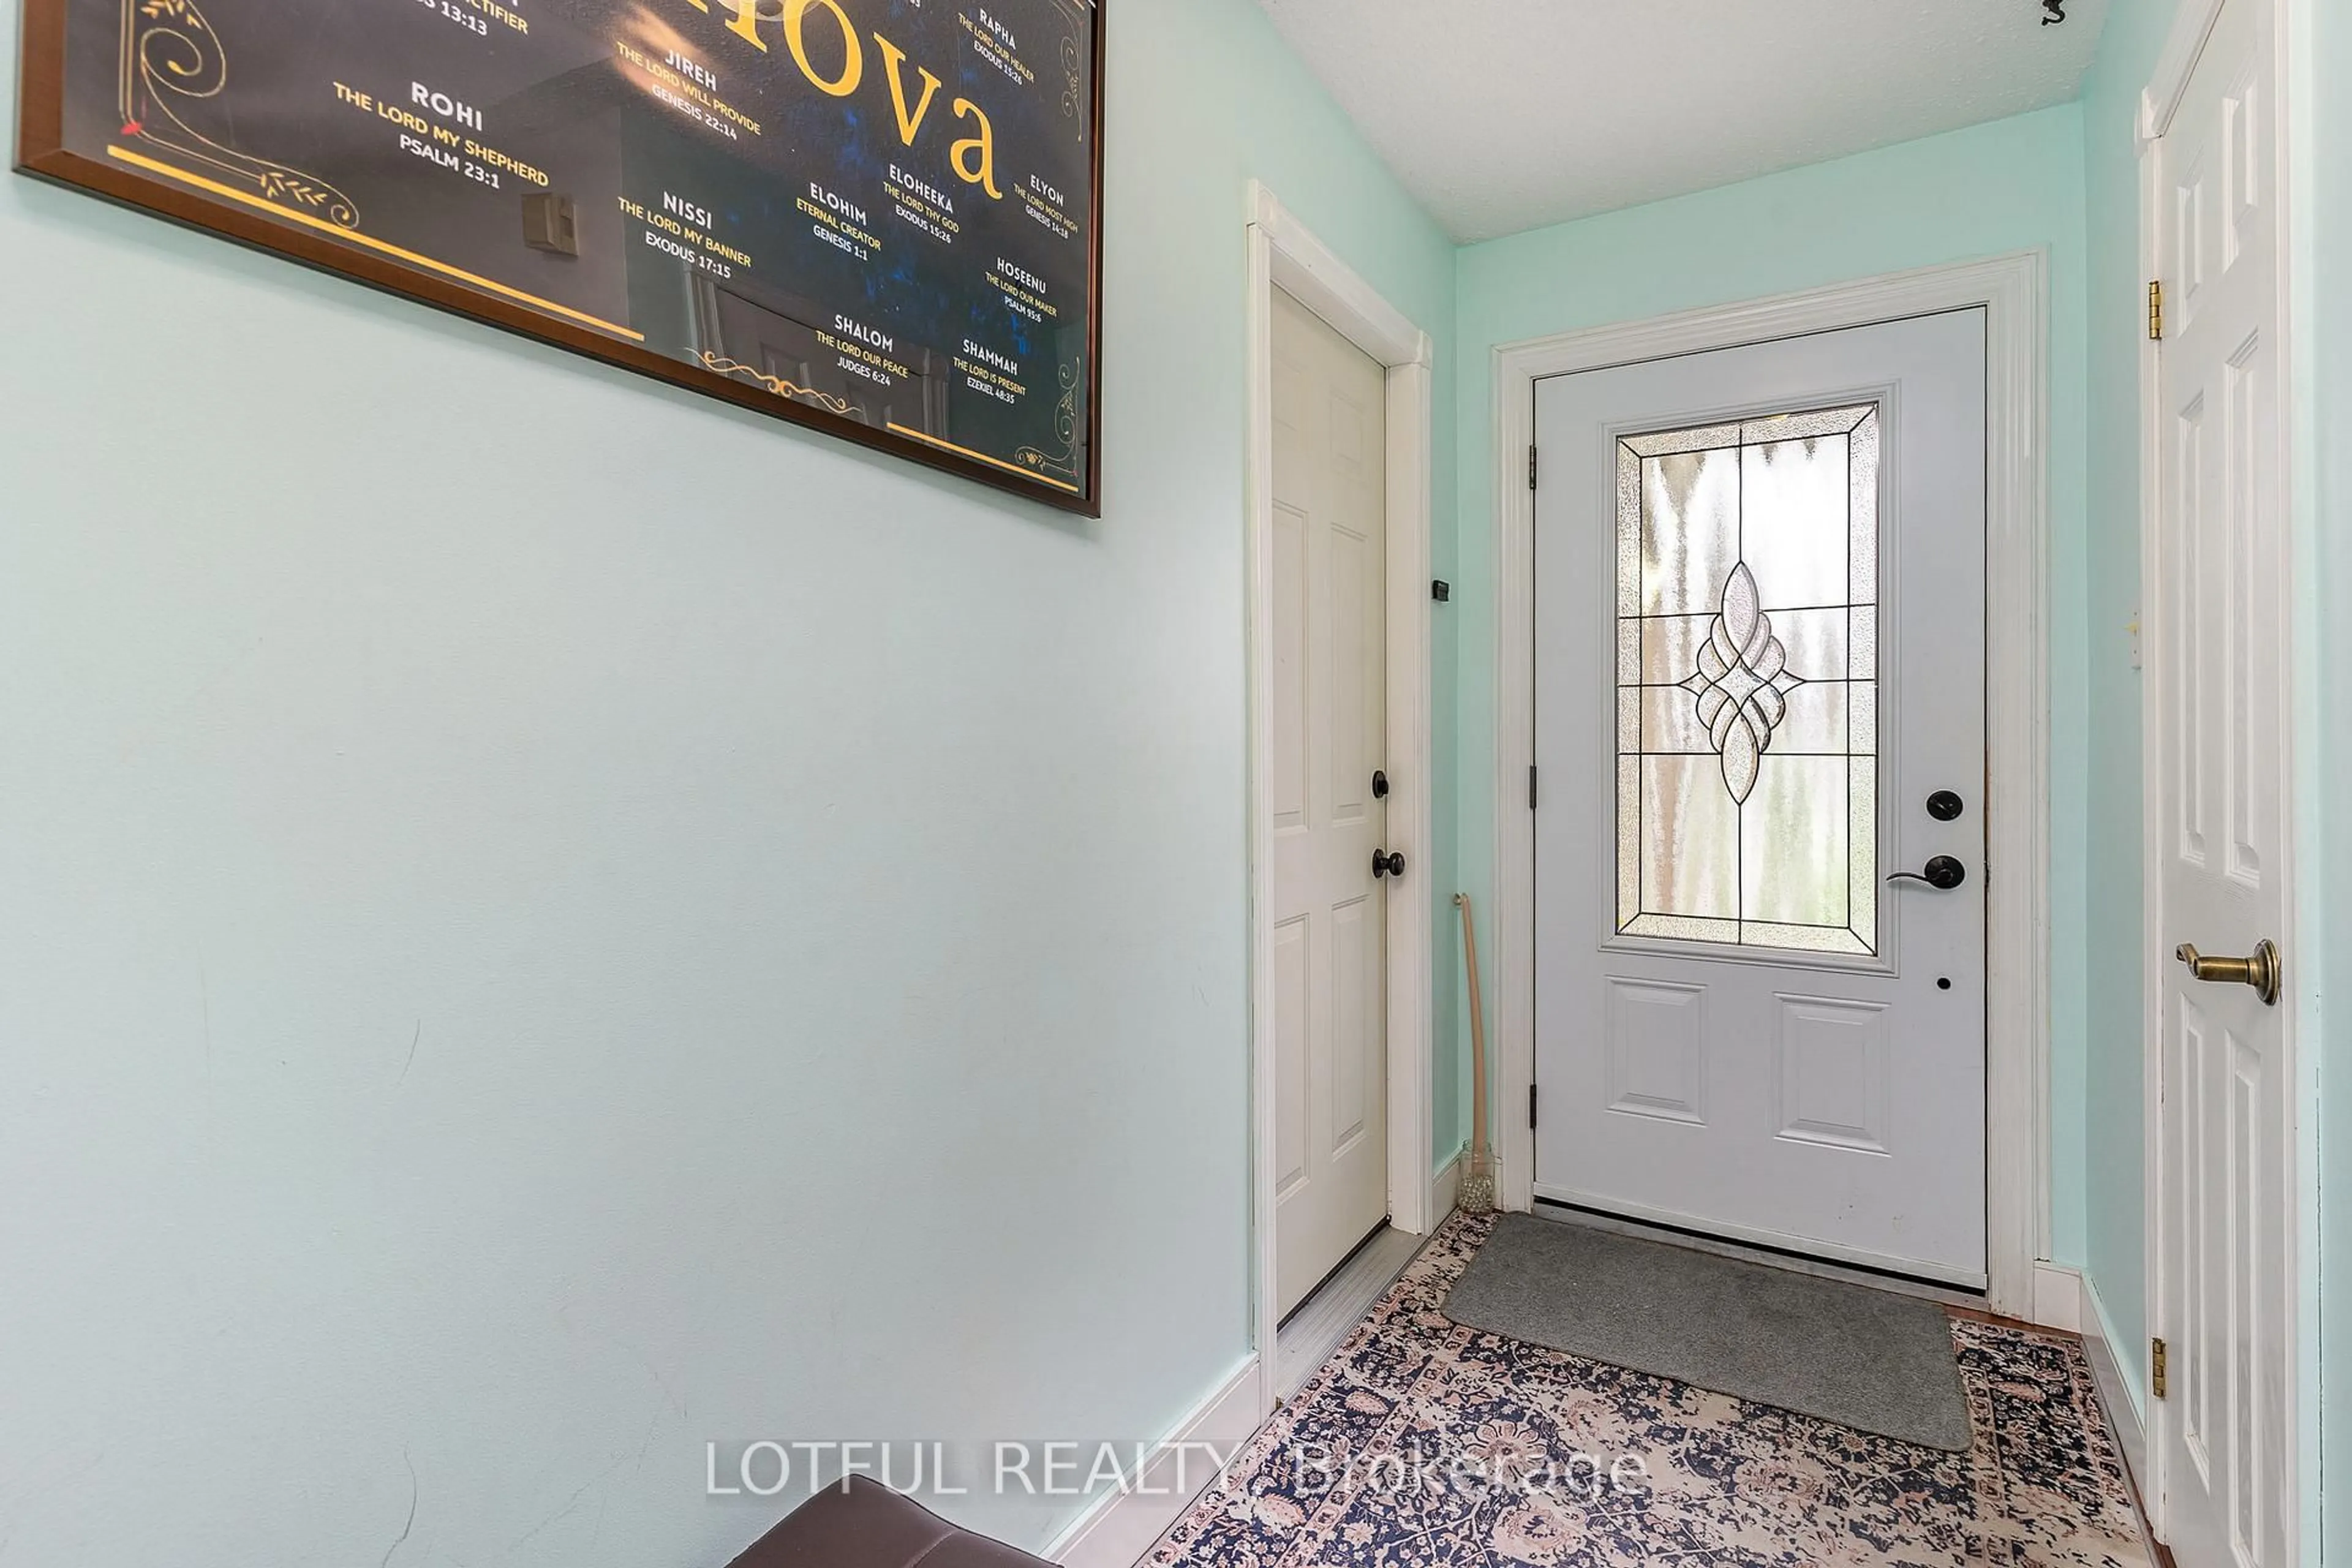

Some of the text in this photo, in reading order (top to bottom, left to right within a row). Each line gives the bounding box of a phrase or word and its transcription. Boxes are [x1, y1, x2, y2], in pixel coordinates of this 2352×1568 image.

[442, 1, 487, 36] 13:13
[980, 7, 1016, 50] RAPHA
[958, 12, 1035, 83] THE LORD OUR HEALER
[974, 40, 1023, 85] EXODUS 15:26
[617, 41, 761, 135] THE LORD WILL PROVIDE
[666, 49, 717, 91] JIREH
[411, 81, 483, 131] ROHI
[652, 84, 737, 140] GENESIS 22:14
[686, 0, 1003, 200] ova
[333, 81, 549, 187] THE LORD MY SHEPHERD
[399, 134, 499, 189] PSALM 23:1
[663, 191, 712, 229] NISSI
[810, 182, 867, 226] ELOHIM
[883, 181, 959, 233] THE LORD THY GOD
[889, 163, 953, 214] ELOHEEKA
[1014, 183, 1026, 199] THE
[1027, 193, 1044, 210] LORD
[1046, 205, 1063, 222] MOST
[1030, 173, 1063, 206] ELYON
[618, 196, 751, 267] THE LORD MY BANNER
[797, 197, 881, 251] ETERNAL CREATOR
[895, 204, 951, 243] EXODUS 15:26
[1025, 204, 1050, 227] GENESIS
[646, 231, 731, 279] EXODUS 17:15
[813, 224, 868, 261] GENESIS 1:1
[985, 271, 1057, 317] THE LORD OUR MAKER
[997, 257, 1046, 293] HOSEENU
[1005, 295, 1026, 315] PSALM
[816, 330, 908, 379] THE LORD OUR PEACE
[834, 314, 893, 352] SHALOM
[837, 356, 891, 386] JUDGES 6:24
[953, 356, 1026, 396] THE LORD IS PRESENT
[963, 339, 1017, 375] SHAMMAH
[967, 377, 1015, 404] EZEKIEL 48:35
